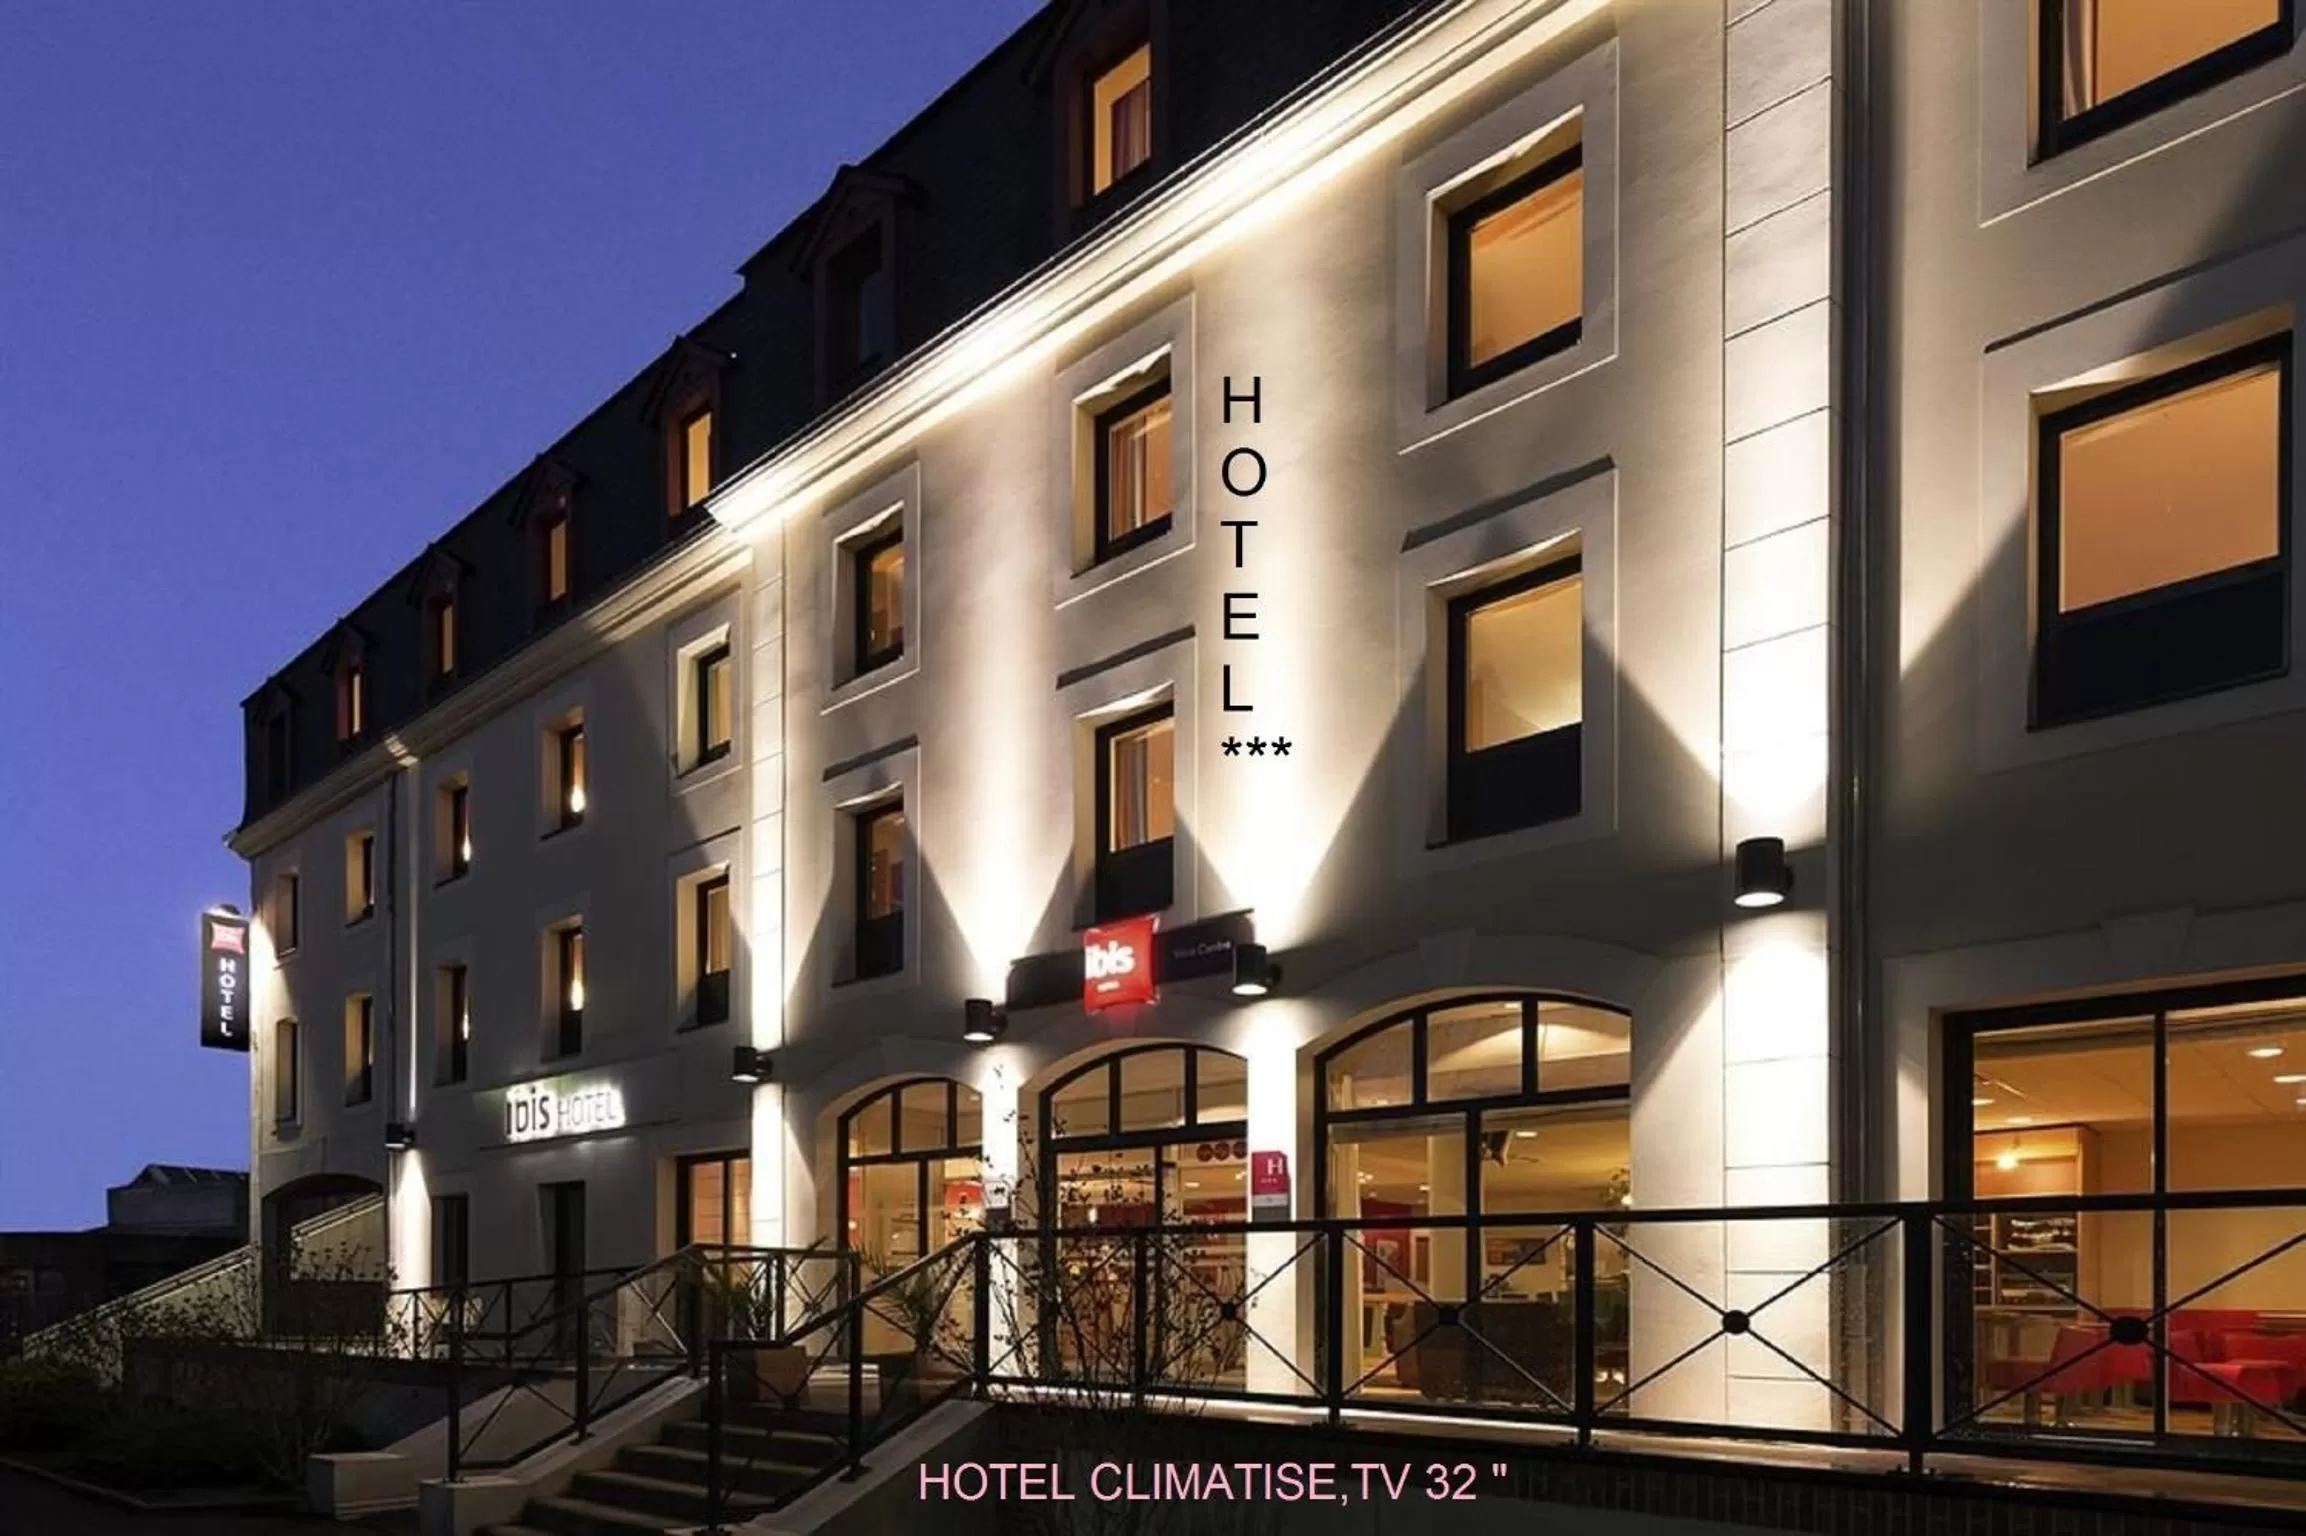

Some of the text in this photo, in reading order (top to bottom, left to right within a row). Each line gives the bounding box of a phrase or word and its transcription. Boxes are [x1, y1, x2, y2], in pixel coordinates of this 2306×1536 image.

[1084, 940, 1135, 979] ibis
[218, 957, 237, 1037] HOTEL
[556, 1091, 617, 1129] HOTEL
[1266, 1156, 1284, 1175] H
